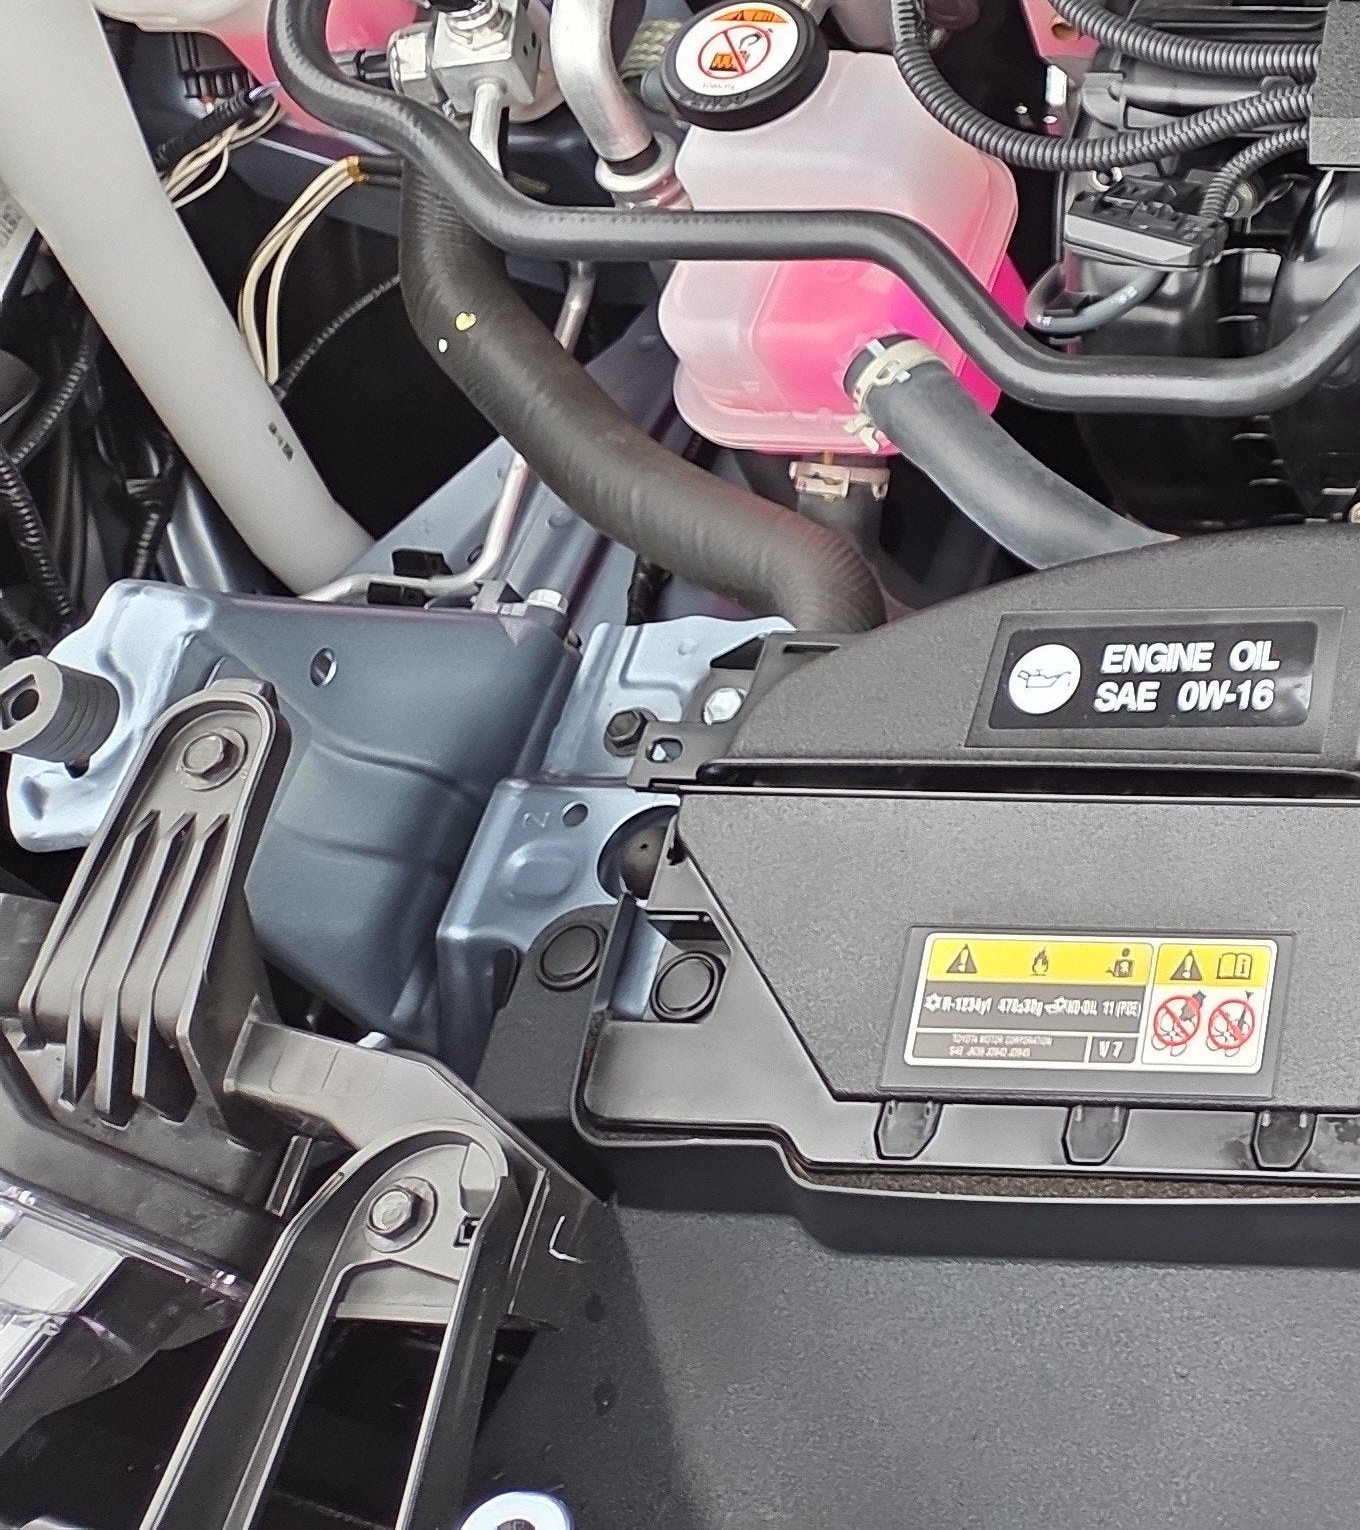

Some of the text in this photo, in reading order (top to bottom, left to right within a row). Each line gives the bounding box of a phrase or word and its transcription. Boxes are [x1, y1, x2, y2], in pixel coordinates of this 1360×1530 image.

[1100, 639, 1281, 675] ENGINE OIL
[1094, 678, 1276, 713] SAE 0W-16
